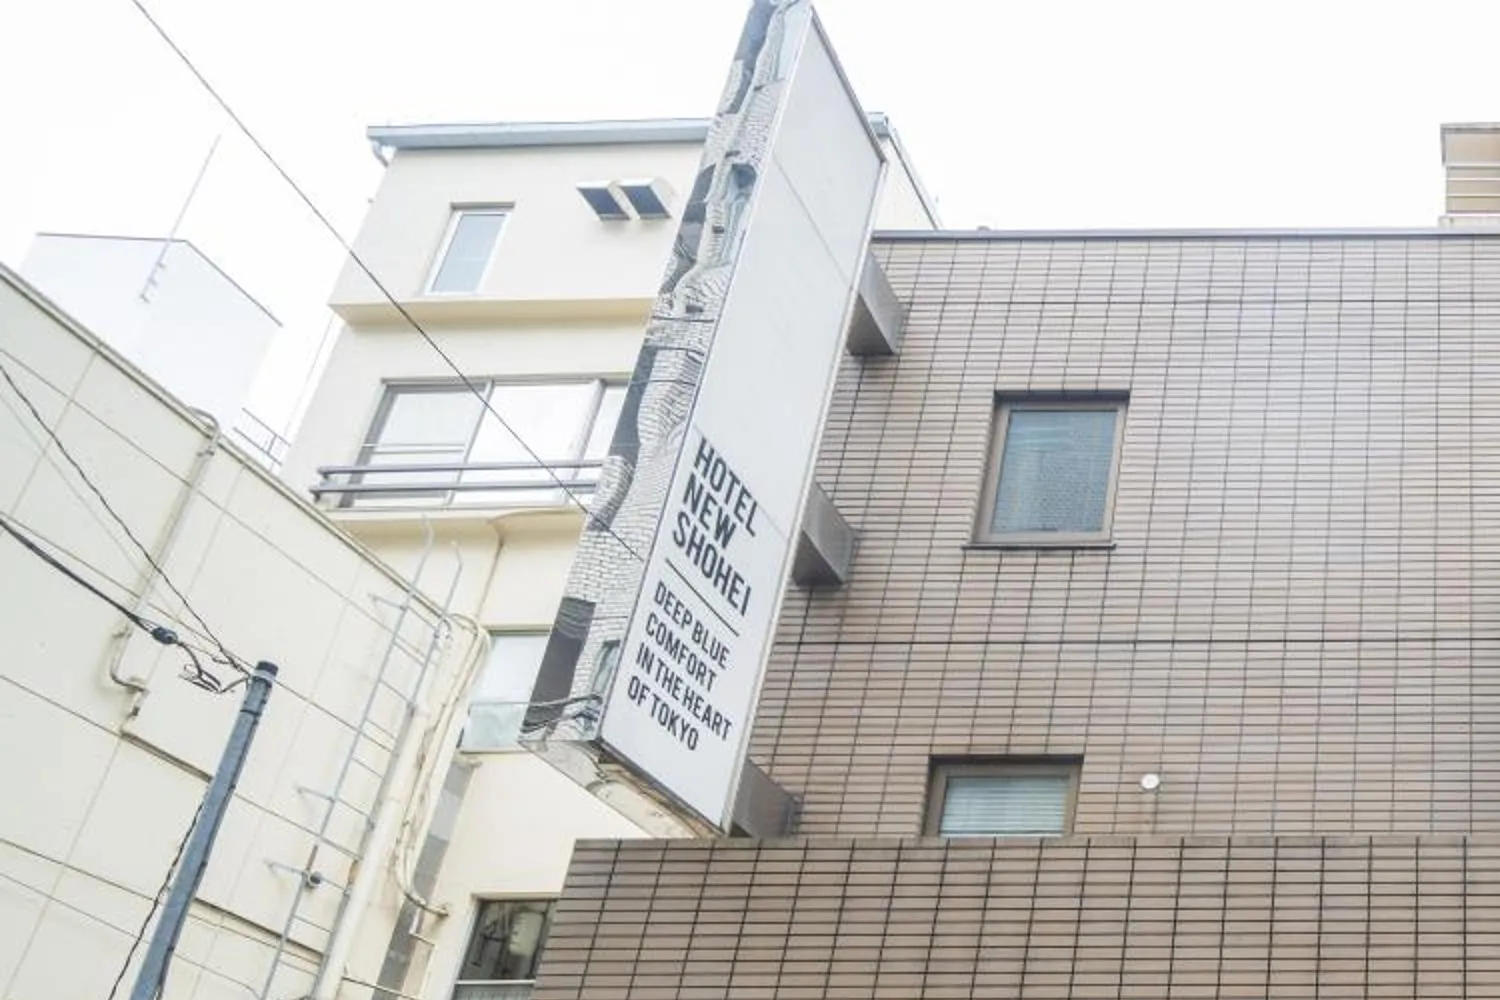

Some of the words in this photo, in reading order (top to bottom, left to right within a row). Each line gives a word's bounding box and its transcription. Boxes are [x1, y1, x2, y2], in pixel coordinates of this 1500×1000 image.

[682, 473, 738, 551] NEW
[693, 437, 758, 538] HOTEL
[671, 511, 752, 618] SHOHEI
[644, 613, 717, 692] COMFORT
[654, 580, 692, 632] DEEP
[691, 620, 732, 671] BLUE
[627, 675, 652, 705] OF
[651, 696, 700, 752] TOKYO
[635, 642, 656, 675] IN
[655, 662, 684, 700] THE
[683, 684, 733, 742] HEART
